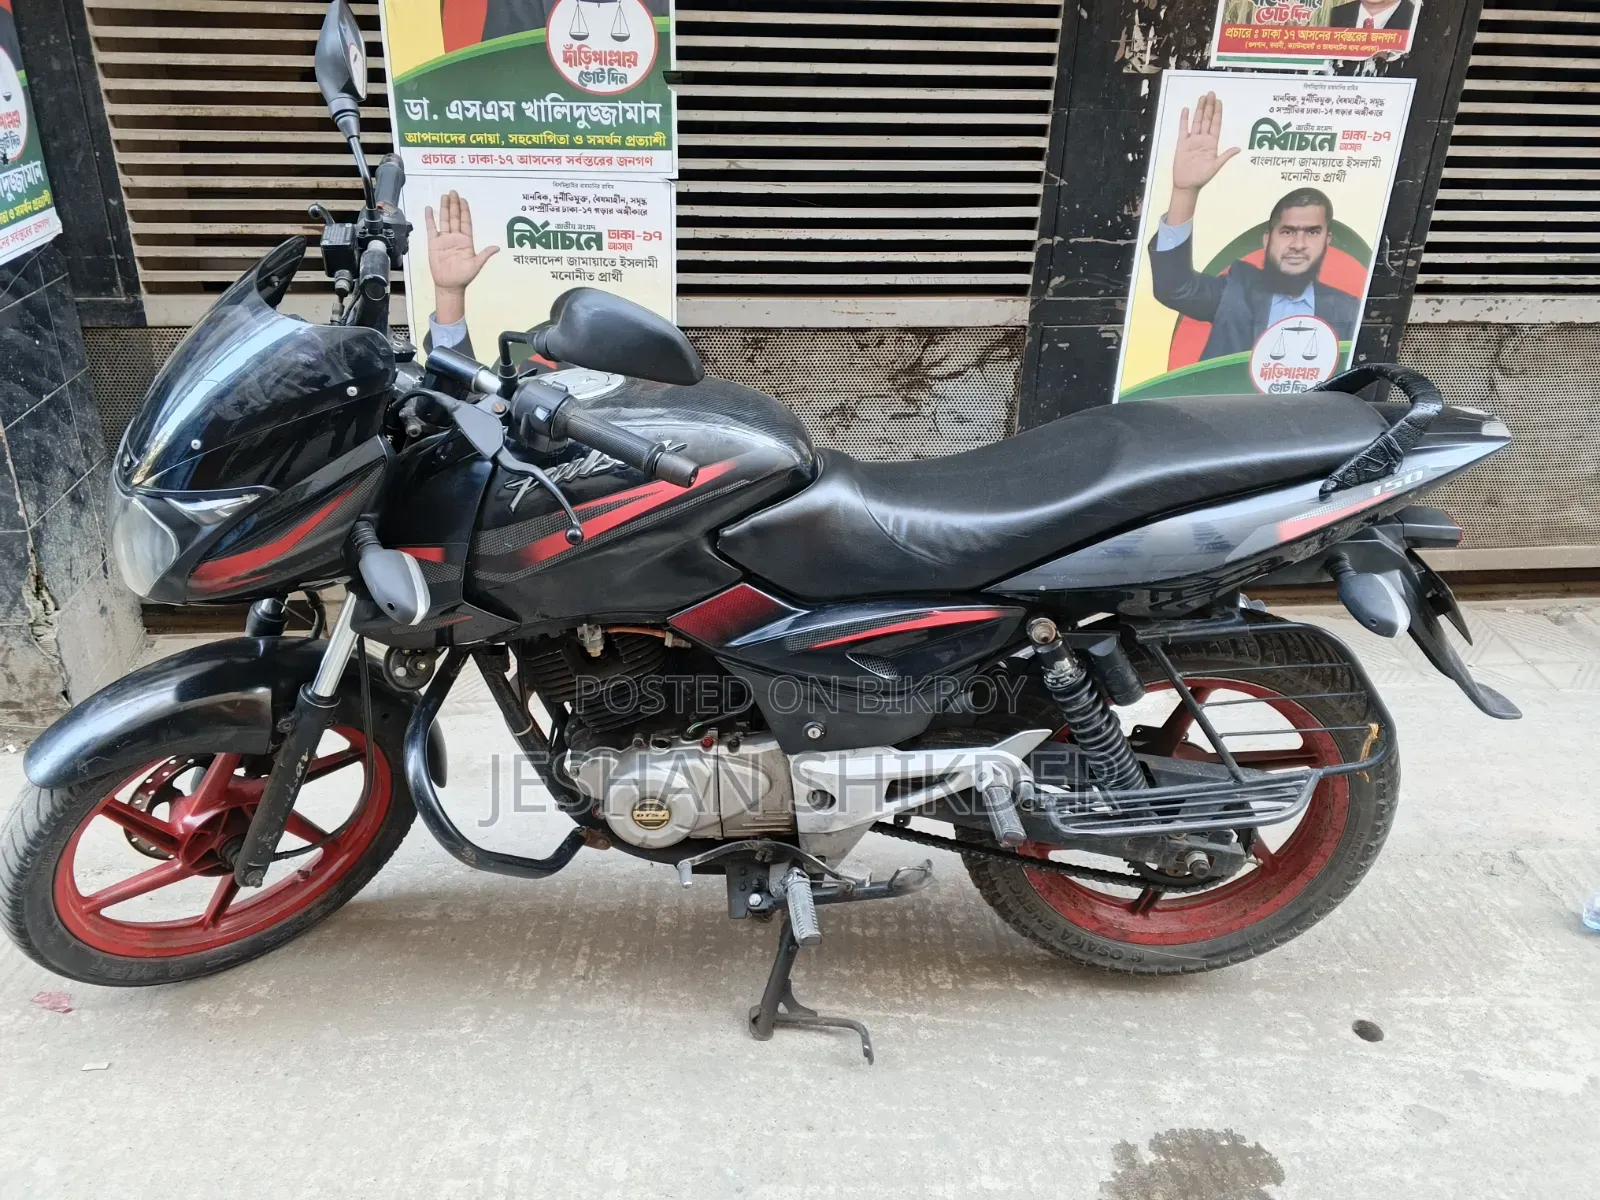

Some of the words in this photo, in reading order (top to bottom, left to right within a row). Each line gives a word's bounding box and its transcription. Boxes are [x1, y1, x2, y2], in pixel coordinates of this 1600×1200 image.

[1256, 4, 1290, 23] ভোট
[1290, 5, 1311, 21] দিন
[1225, 27, 1252, 38] প্রচারে
[1261, 29, 1281, 40] ঢাকা
[1283, 30, 1296, 40] ১৭
[1298, 29, 1331, 40] আসনের
[1334, 28, 1367, 42] সর্বস্তরের
[1371, 33, 1396, 44] জনগণ
[562, 44, 639, 70] দাঁড়িপাল্লায়
[578, 67, 607, 88] ভোট
[607, 69, 628, 86] দিন
[403, 97, 438, 122] ডা.
[446, 100, 516, 122] এসএম
[521, 93, 662, 130] খালিদুজ্জামান
[404, 131, 466, 144] আপনাদের
[469, 132, 505, 147] দোয়া,
[508, 131, 569, 146] সহযোগিতা
[573, 136, 584, 145] ও
[587, 132, 622, 146] সমর্থন
[625, 132, 666, 147] প্রত্যাশী
[1248, 117, 1338, 151] নির্বাচনে
[1341, 129, 1391, 142] ঢাকা-১৭
[1339, 142, 1362, 152] আসনে
[422, 153, 457, 166] প্রচারে
[468, 154, 514, 166] ঢাকা-১৭
[517, 154, 562, 166] আসনের
[566, 153, 613, 168] সর্বস্তরের
[616, 156, 654, 168] জনগণ
[1250, 154, 1296, 167] বাংলাদেশ
[1298, 155, 1344, 168] জামায়াতে
[1346, 156, 1382, 169] ইসলামী
[1281, 170, 1321, 182] মনোনীত
[1322, 170, 1348, 184] প্রার্থী
[562, 206, 593, 214] ঢাকা-১৭
[506, 216, 603, 252] নির্বাচনে
[554, 222, 576, 231] জাতীয়
[608, 228, 662, 242] ঢাকা-১৭
[608, 242, 632, 252] আসনে
[514, 254, 563, 267] বাংলাদেশ
[566, 255, 616, 268] জামায়াতে
[619, 254, 658, 269] ইসলামী
[550, 268, 595, 282] মনোনীত
[598, 269, 624, 284] প্রার্থী
[1260, 362, 1320, 383] দাঁড়িপাল্লায়
[1373, 470, 1424, 496] 150
[1059, 928, 1125, 961] OSAKA
